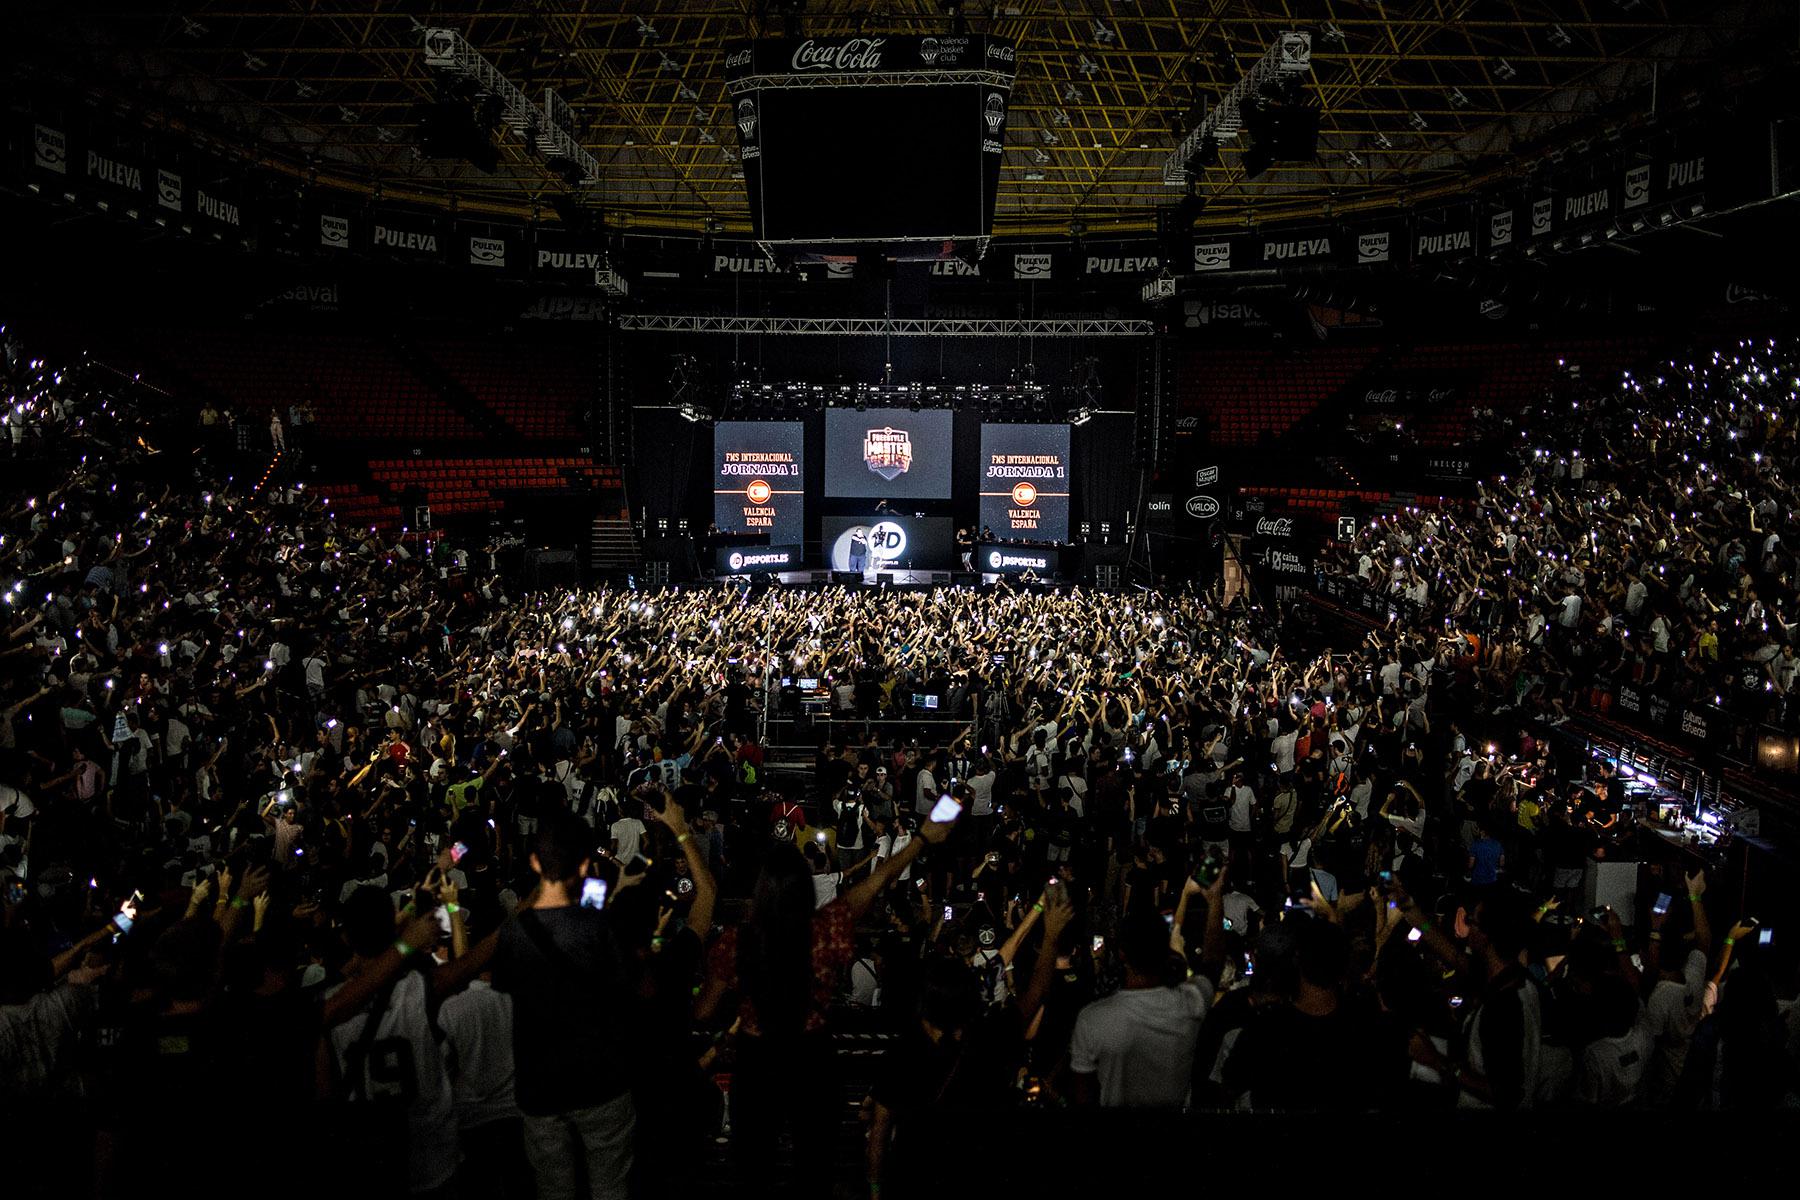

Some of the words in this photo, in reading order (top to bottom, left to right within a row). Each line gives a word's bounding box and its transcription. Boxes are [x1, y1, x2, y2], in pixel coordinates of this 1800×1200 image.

[726, 50, 752, 69] Coca-Cola
[792, 38, 887, 70] Coca-Cola
[987, 44, 1015, 62] Coca-Cola
[88, 149, 143, 192] PULEVA
[1667, 156, 1704, 190] PULE
[198, 190, 240, 226] PULEVA
[1565, 188, 1609, 221] PULEVA
[374, 225, 437, 252] PULEVA
[1418, 231, 1471, 256] PULEVA
[473, 241, 503, 252] PULEVA
[1196, 246, 1228, 256] PULEVA
[1263, 238, 1331, 261] PULEVA
[537, 250, 604, 269] PULEV
[1017, 257, 1049, 265] PULEVA
[929, 261, 980, 276] LEVA
[868, 441, 911, 456] MASTER
[726, 453, 740, 462] FMS
[742, 453, 793, 462] INTERNACIONAL
[992, 455, 1006, 464] FMS
[1007, 455, 1059, 465] INTERNACIONAL
[721, 464, 788, 475] JORNADA
[791, 464, 799, 475] 1
[987, 466, 1055, 478] JORNADA
[1056, 467, 1064, 478] 1
[743, 507, 776, 517] VALENCIA
[1008, 509, 1041, 519] VALENCIA
[1190, 502, 1216, 512] VALOR
[746, 516, 773, 527] ESPAÑA
[1011, 519, 1038, 529] ESPAÑA
[1256, 516, 1294, 536] Coca-Cola
[1282, 552, 1299, 563] caixa
[1681, 720, 1706, 738] Esfuerzo
